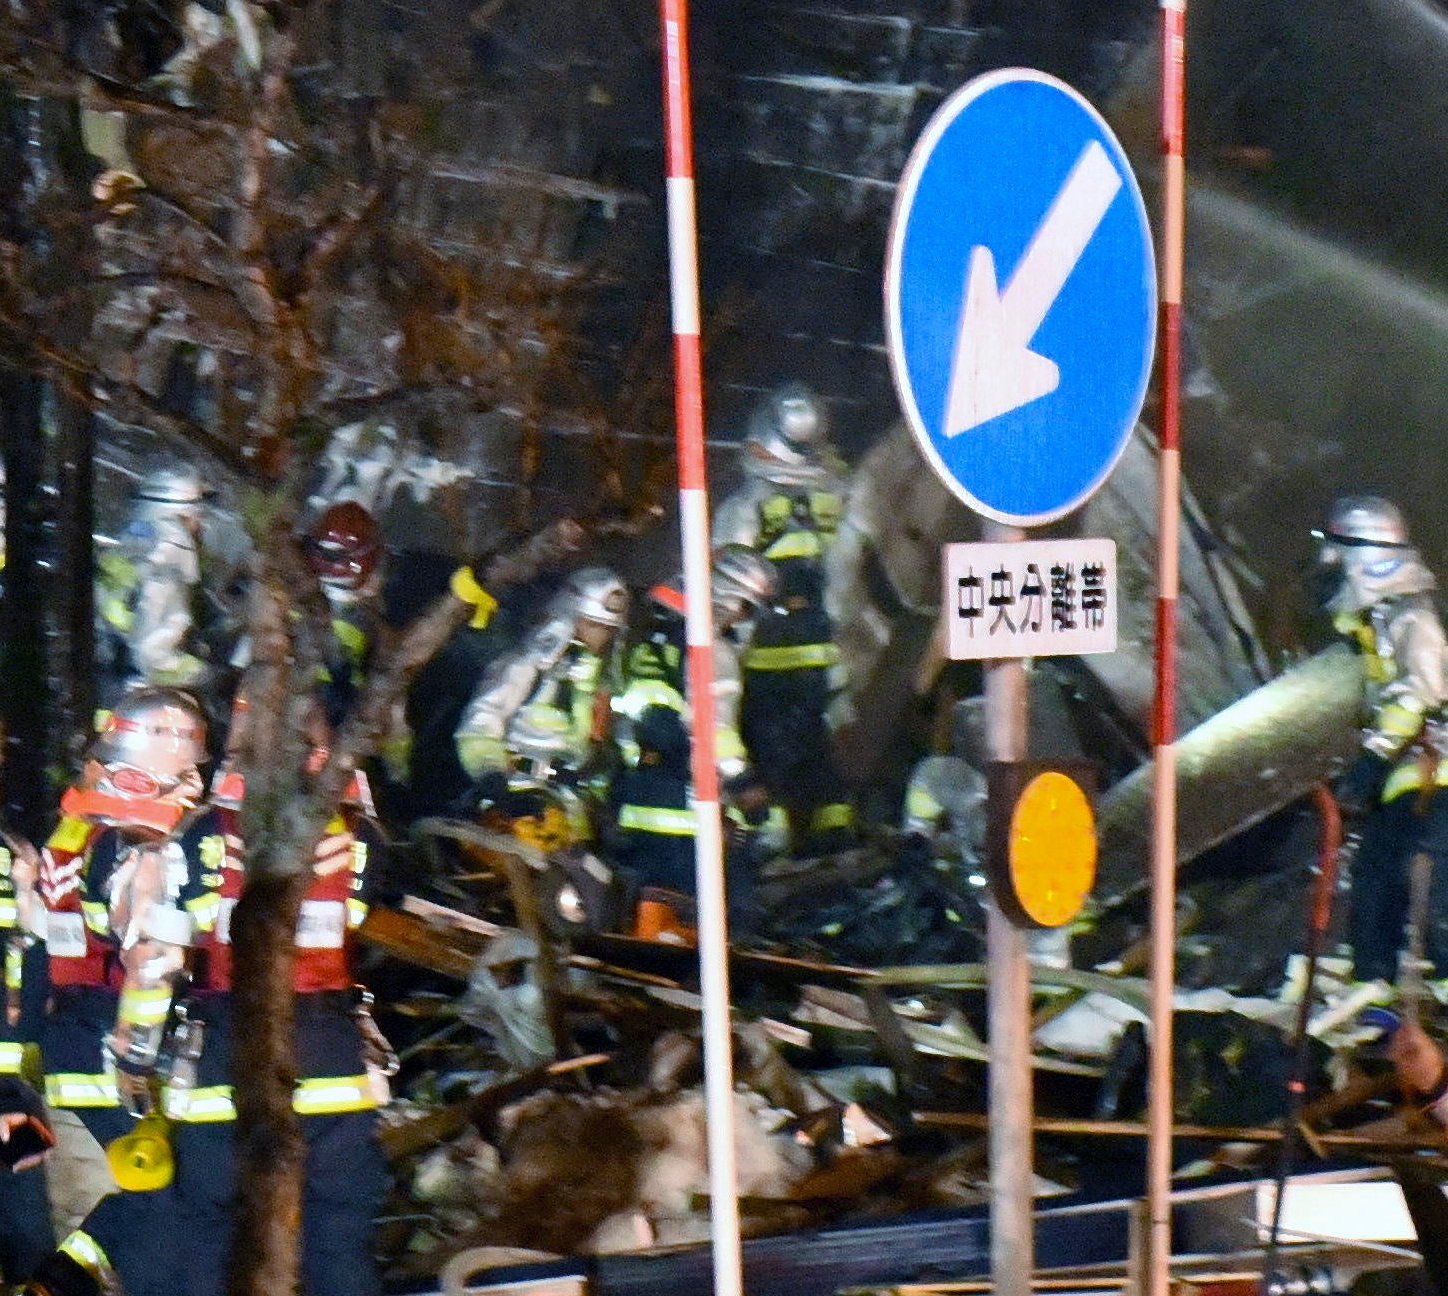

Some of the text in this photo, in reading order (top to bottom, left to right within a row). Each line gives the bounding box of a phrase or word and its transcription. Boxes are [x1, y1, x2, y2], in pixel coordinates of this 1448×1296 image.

[958, 561, 1107, 638] 中央分離帯
